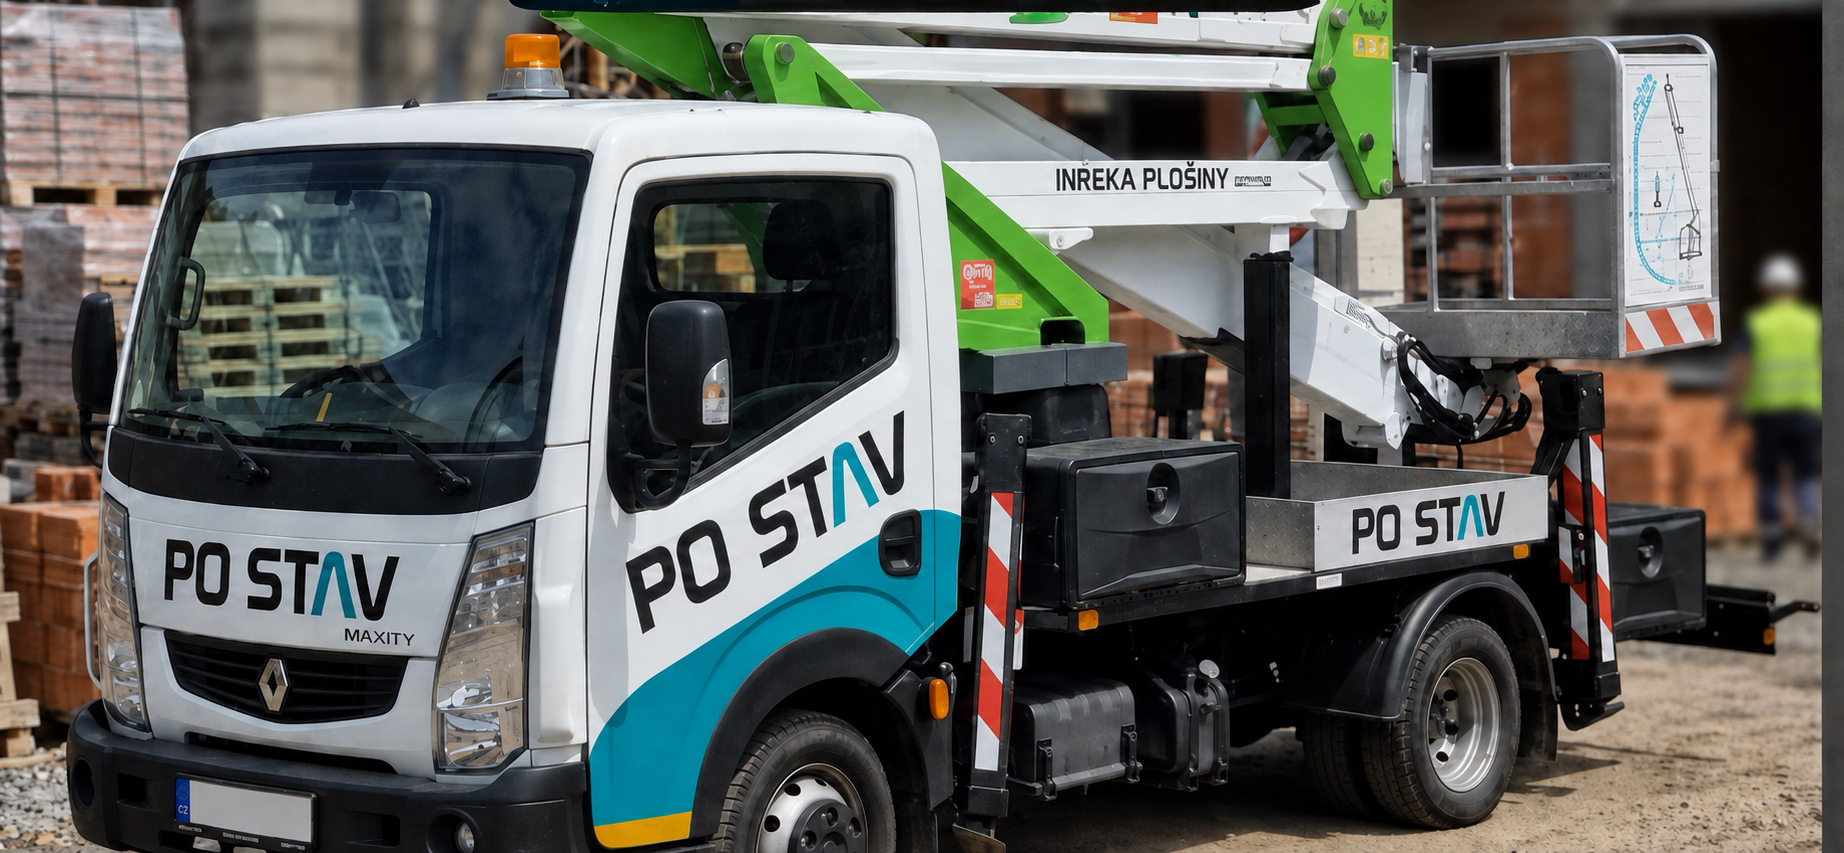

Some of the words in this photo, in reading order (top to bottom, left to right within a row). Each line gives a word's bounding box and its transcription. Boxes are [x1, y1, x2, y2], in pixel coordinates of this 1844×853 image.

[1143, 161, 1229, 190] PLOŠINY
[625, 519, 732, 635] PO
[748, 410, 905, 568] STAV
[1352, 504, 1401, 554] PO
[1415, 491, 1505, 546] STAV
[164, 539, 231, 606] PO
[247, 547, 400, 621] STAV
[344, 628, 415, 646] MAXITY
[178, 804, 188, 815] CZ
